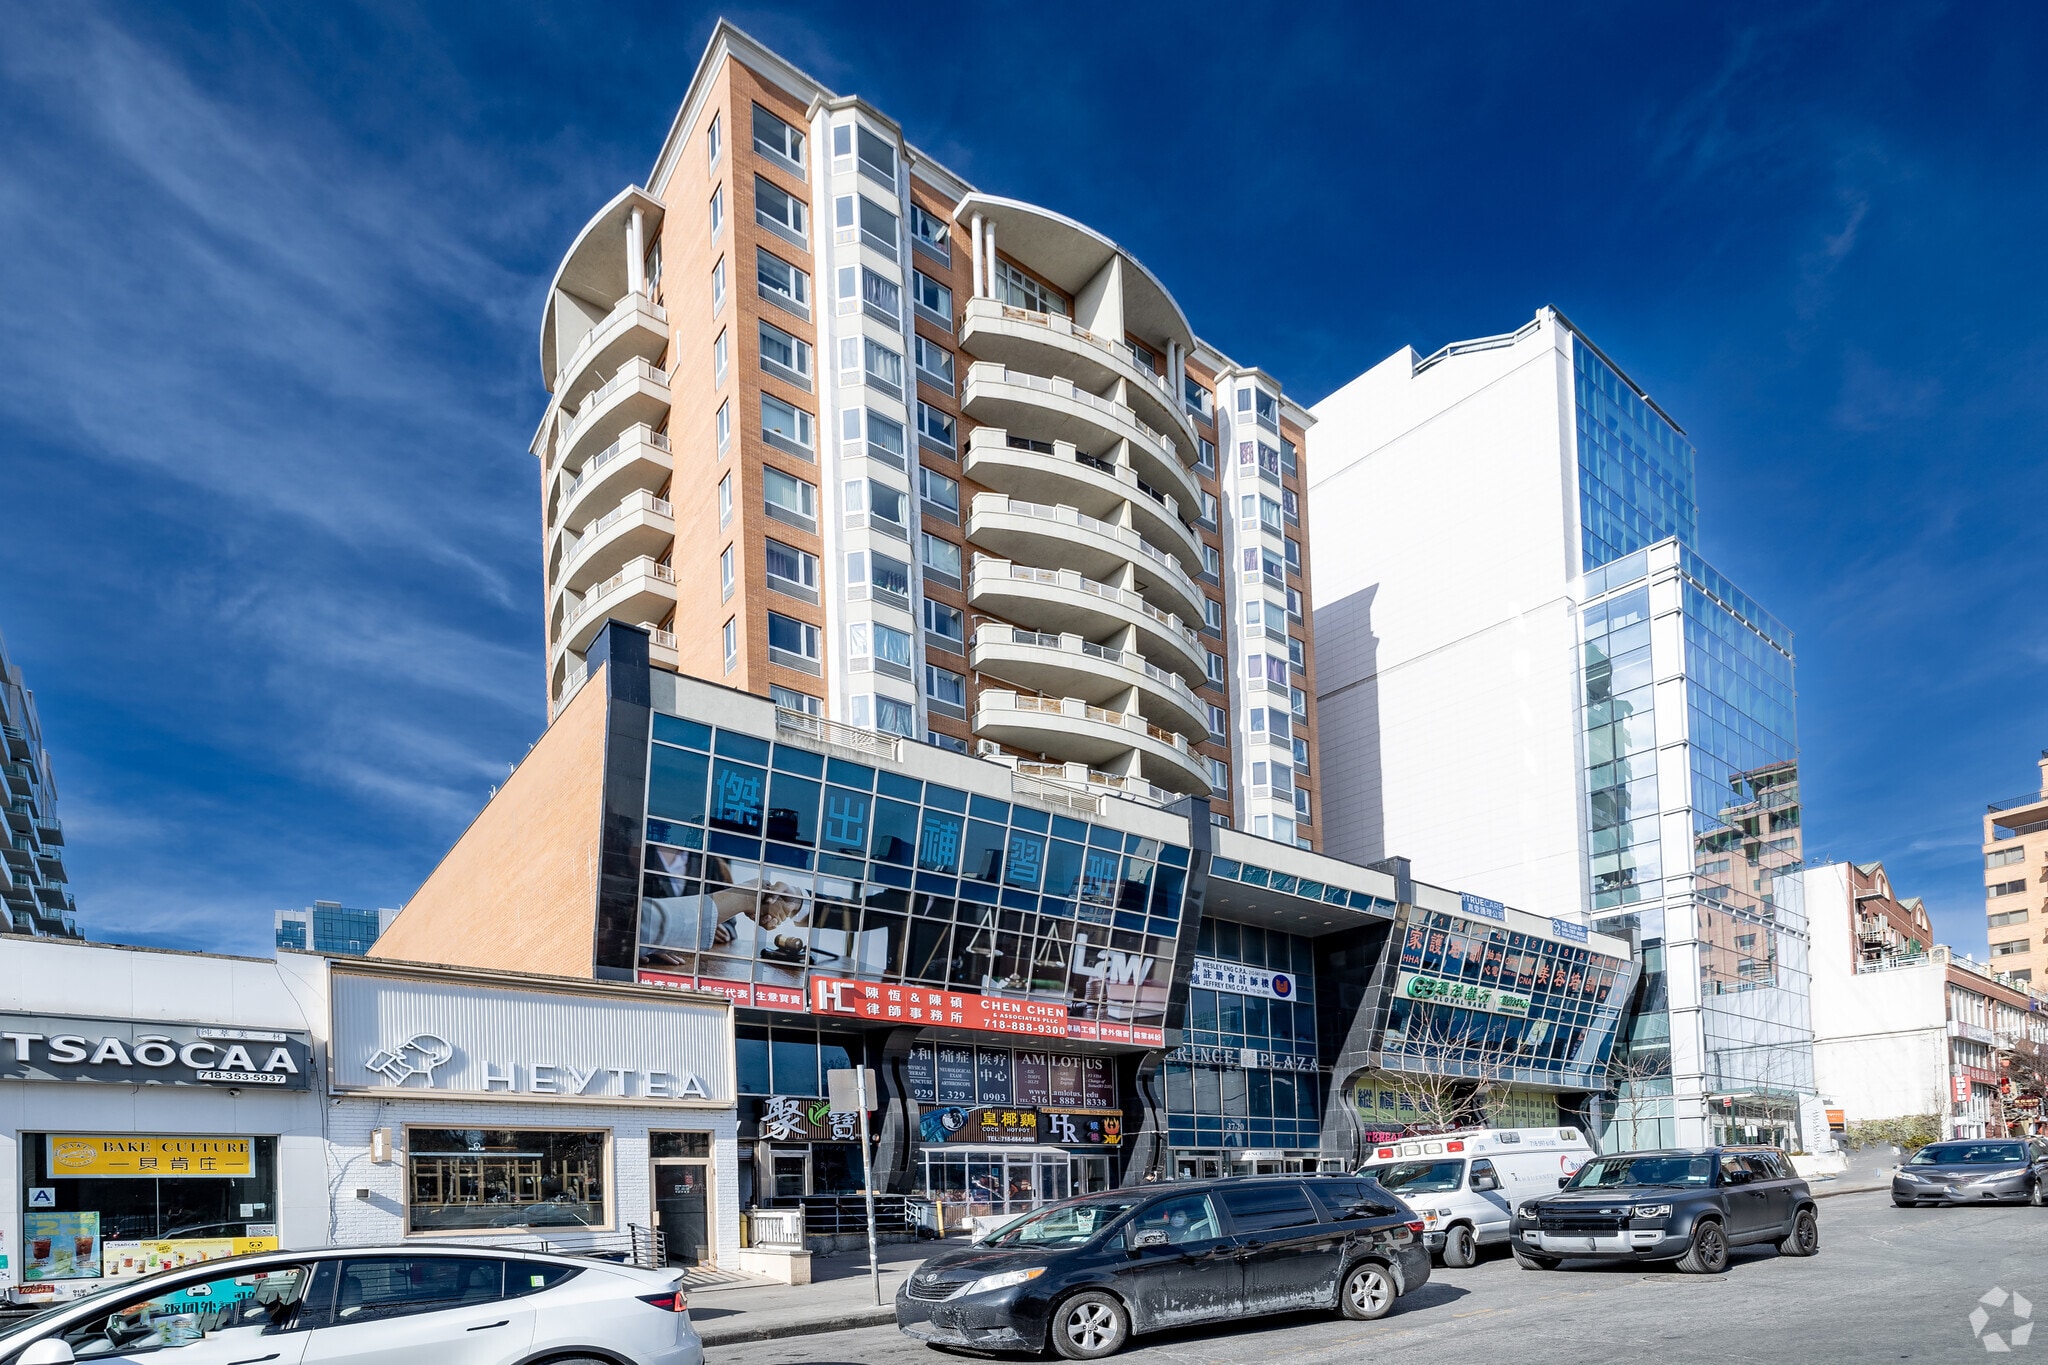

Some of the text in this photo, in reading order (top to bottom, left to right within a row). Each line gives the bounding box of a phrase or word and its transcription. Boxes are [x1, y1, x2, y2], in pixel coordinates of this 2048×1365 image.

[717, 769, 1117, 898] 傑出補習班
[1466, 893, 1504, 911] TRUECARE
[1402, 954, 1419, 964] HHA
[1202, 962, 1222, 971] WESLEY
[1223, 965, 1234, 973] ENG
[1203, 980, 1224, 989] JEFFREY
[1225, 982, 1236, 990] ENG
[1519, 976, 1532, 986] CNA
[755, 991, 801, 1005] 生意買賣
[1433, 996, 1487, 1009] GLOBAL BANK
[866, 1003, 963, 1024] 律師事務所
[980, 999, 1065, 1018] CHEN CHEN
[1000, 1013, 1041, 1023] ASSOCIATES
[984, 1018, 1065, 1036] 718-888-9300
[940, 1049, 970, 1064] 痛症
[980, 1052, 1007, 1066] 医疗
[1021, 1054, 1046, 1066] AM
[1260, 1053, 1319, 1072] PLAZA
[201, 1071, 285, 1083] 718-353-5937
[480, 1059, 707, 1099] HEYTEA
[980, 1068, 1008, 1082] 中心
[914, 1088, 934, 1098] 929
[983, 1092, 1006, 1102] 0903
[1031, 1095, 1048, 1103] 516
[1086, 1098, 1107, 1106] 8338
[103, 1141, 250, 1154] BAKE CULTURE
[33, 1190, 51, 1202] A
